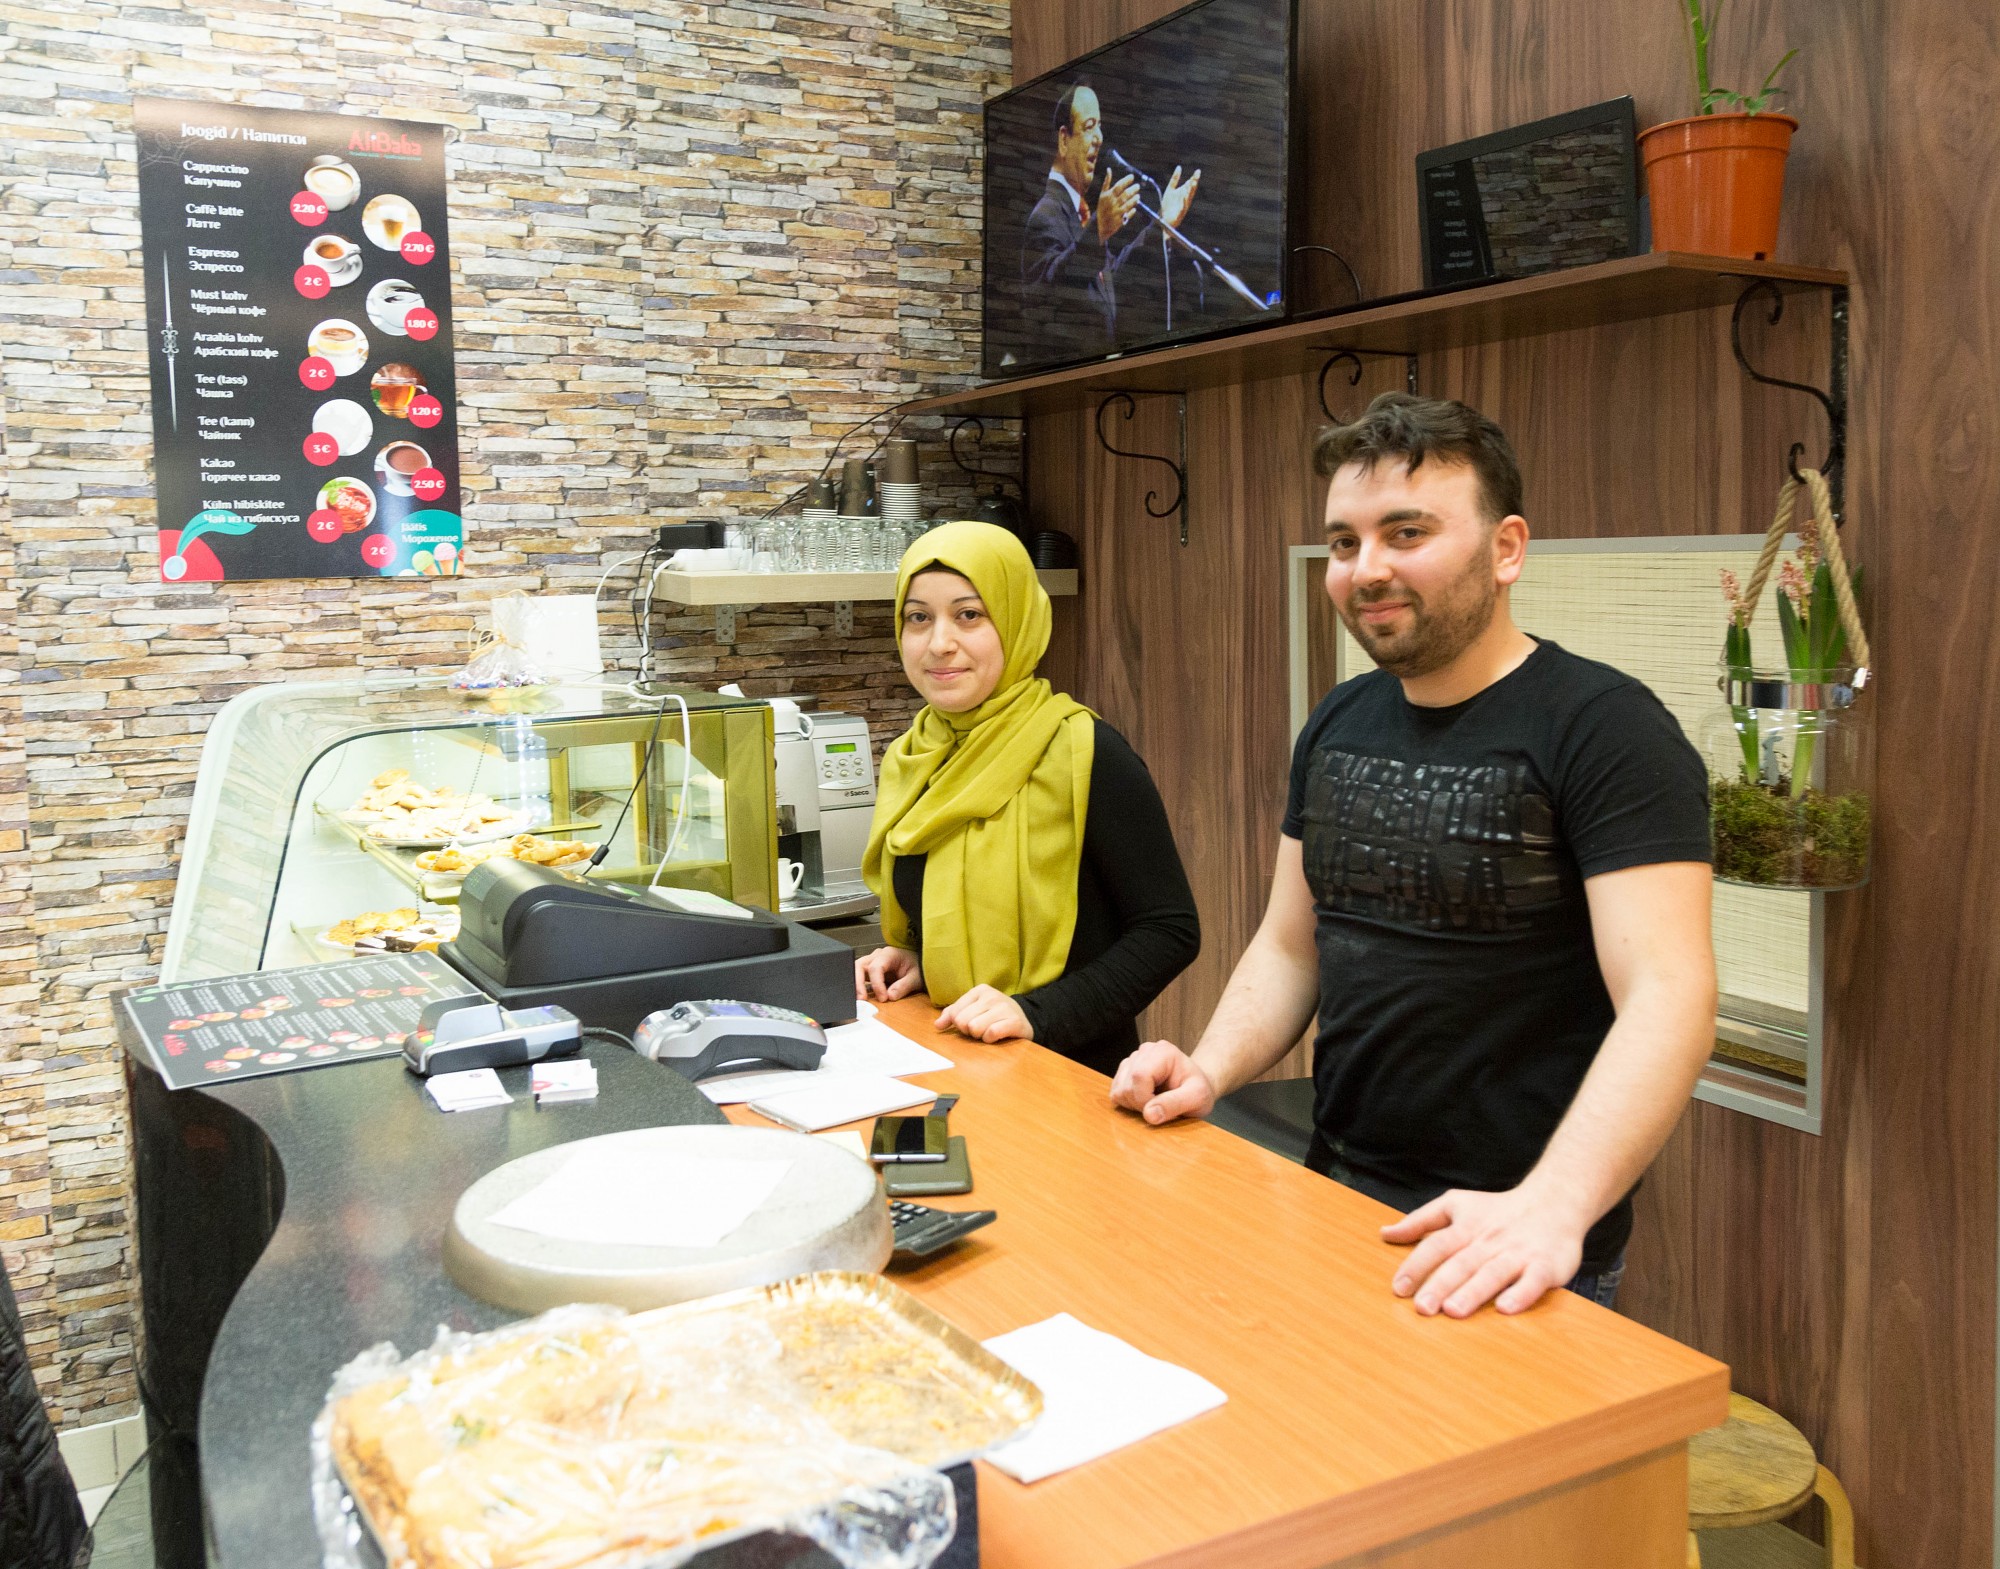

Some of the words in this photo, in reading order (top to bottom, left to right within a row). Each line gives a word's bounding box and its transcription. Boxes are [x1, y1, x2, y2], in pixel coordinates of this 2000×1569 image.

[181, 122, 228, 141] Joogid
[231, 128, 239, 139] /
[242, 128, 307, 145] Напитки
[348, 129, 422, 155] AliBaba
[183, 160, 249, 175] Cappuccino
[184, 175, 242, 188] Капучино
[185, 203, 217, 215] Caffè
[218, 205, 244, 217] latte
[186, 217, 221, 229] Латте
[188, 246, 239, 258] Espresso
[188, 260, 244, 273] Эспрессо
[190, 289, 219, 299] Must
[222, 290, 249, 301] kohv
[191, 303, 237, 316] Чёрный
[238, 306, 266, 317] кофе
[193, 332, 236, 342] Araabia
[237, 333, 264, 343] kohv
[194, 345, 249, 358] Арабский
[250, 347, 279, 359] кофе
[195, 374, 216, 384] Tee
[217, 374, 248, 386] (tass)
[196, 388, 234, 398] Чашка
[197, 416, 218, 426] Tee
[219, 416, 255, 428] (kann)
[198, 430, 242, 440] Чайник
[200, 458, 236, 468] Kakao
[201, 472, 247, 484] Горячее
[248, 473, 281, 482] какао
[203, 500, 232, 510] Külm
[234, 500, 285, 510] hibiskitee
[203, 514, 226, 524] Чай
[228, 515, 242, 524] из
[243, 513, 300, 525] гибискуса
[401, 522, 427, 533] Jäätis
[401, 533, 459, 545] Мороженое
